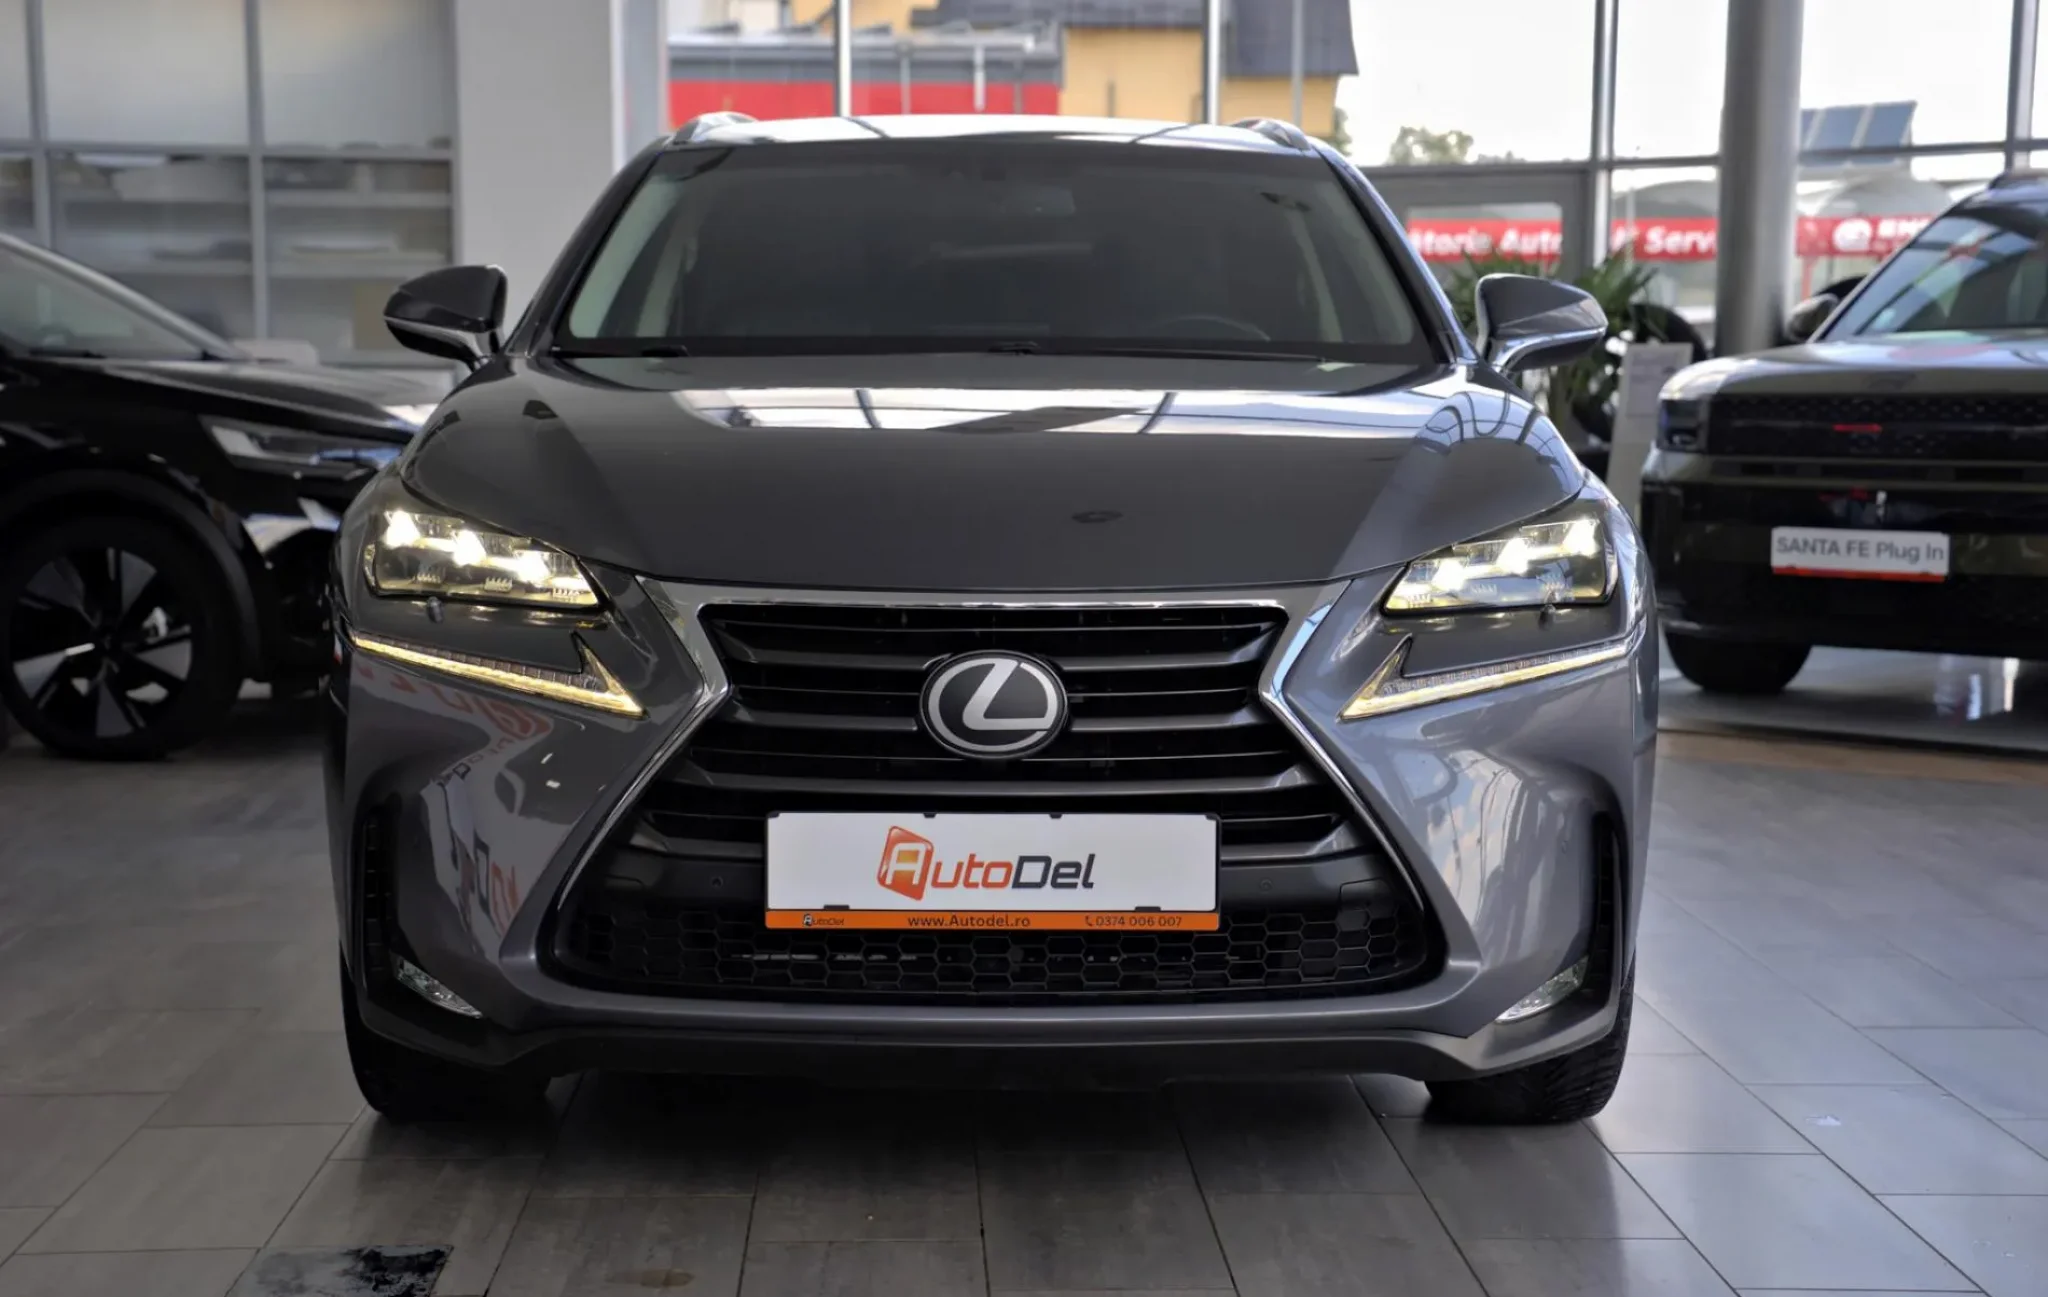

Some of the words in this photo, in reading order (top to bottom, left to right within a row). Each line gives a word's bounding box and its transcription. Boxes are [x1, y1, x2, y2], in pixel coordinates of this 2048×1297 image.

[1777, 536, 1840, 557] SANTA
[1846, 540, 1869, 558] FE
[1876, 541, 1920, 564] Plug
[1926, 544, 1944, 560] In
[876, 825, 1095, 901] AutoDel
[908, 915, 1031, 928] www.Autodel.ro
[1095, 916, 1125, 926] 0374
[1129, 916, 1154, 926] 006
[1158, 916, 1182, 926] 007
